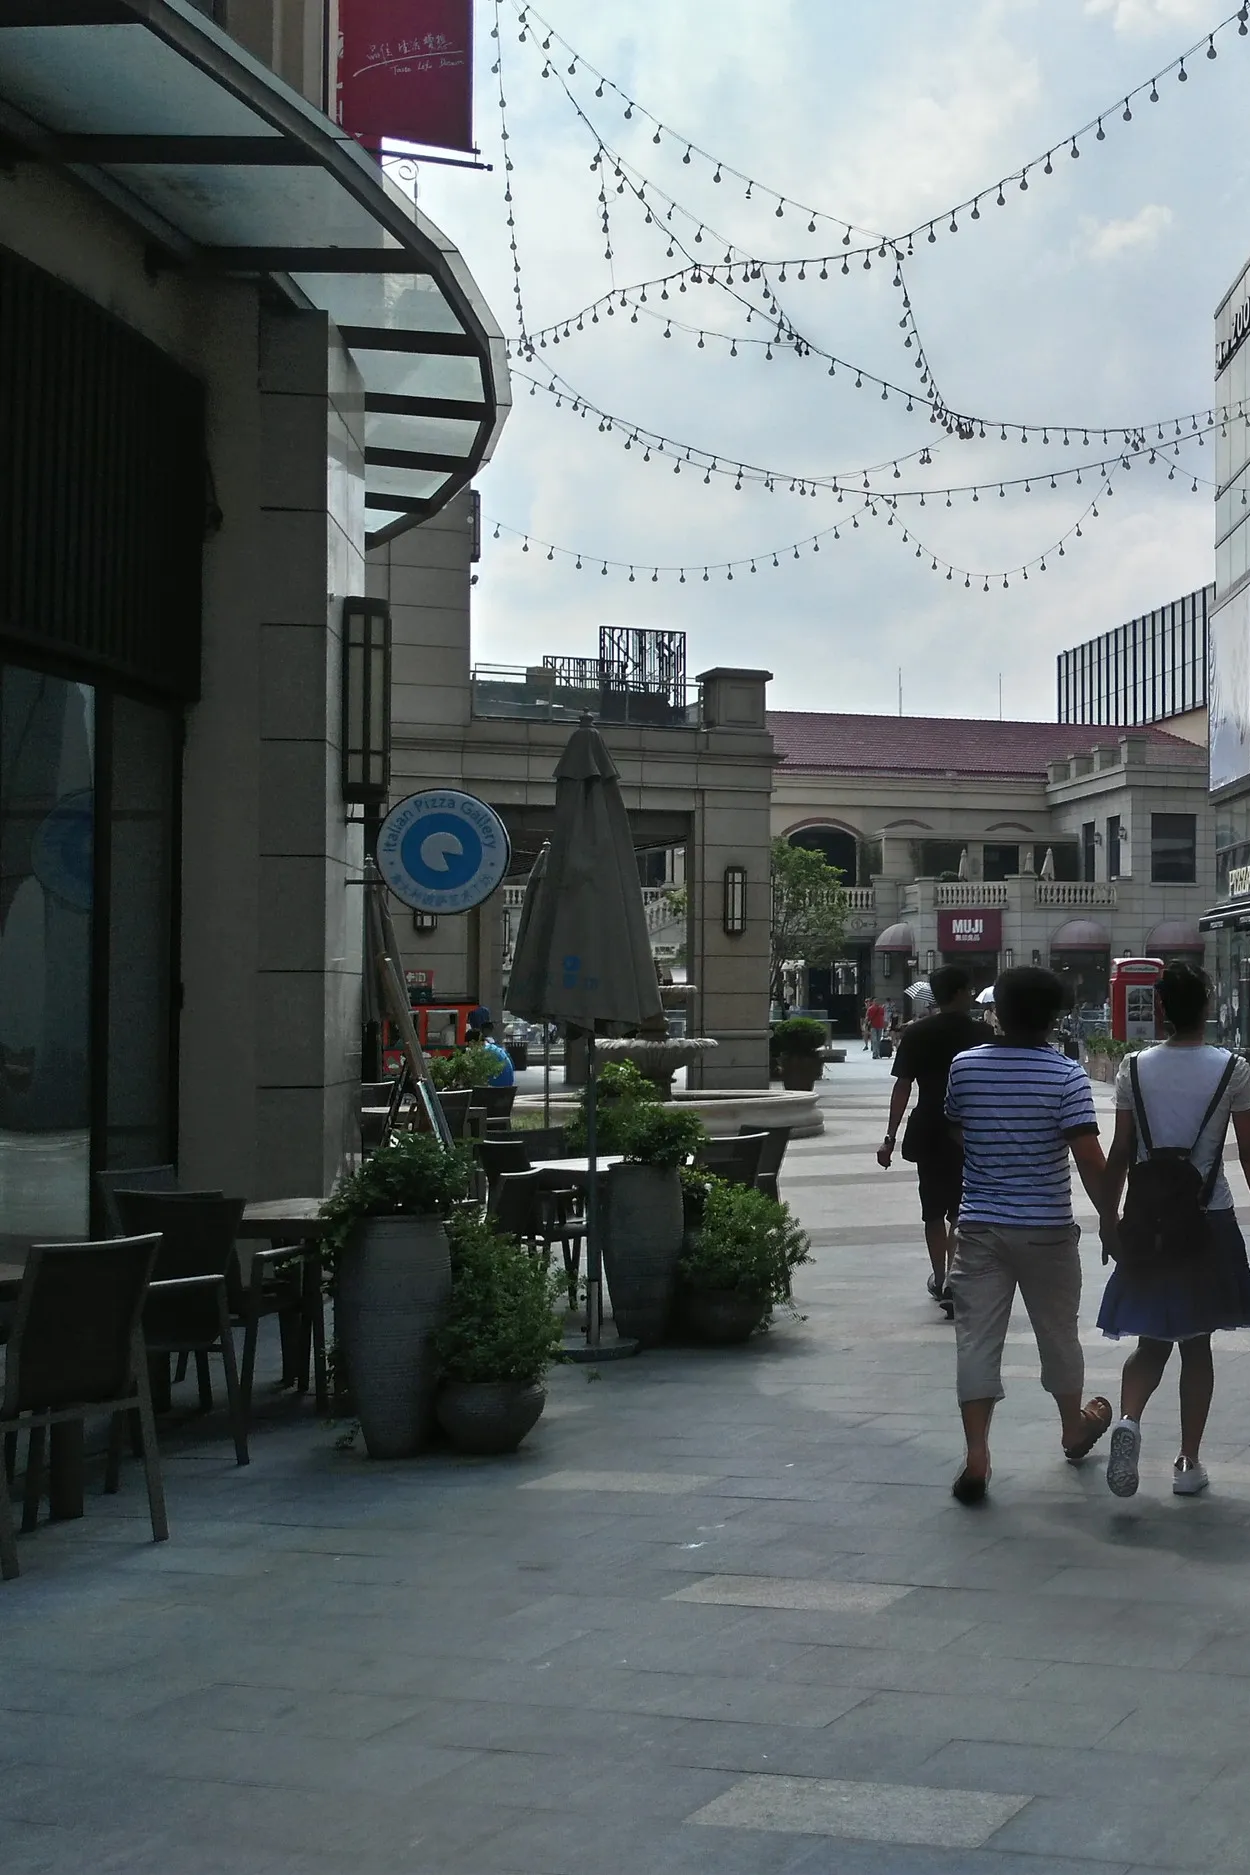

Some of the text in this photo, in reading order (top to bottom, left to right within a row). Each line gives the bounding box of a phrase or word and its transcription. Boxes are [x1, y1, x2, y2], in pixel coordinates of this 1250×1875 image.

[383, 797, 497, 852] Italian Pizza Gallery
[952, 919, 983, 934] MUJI
